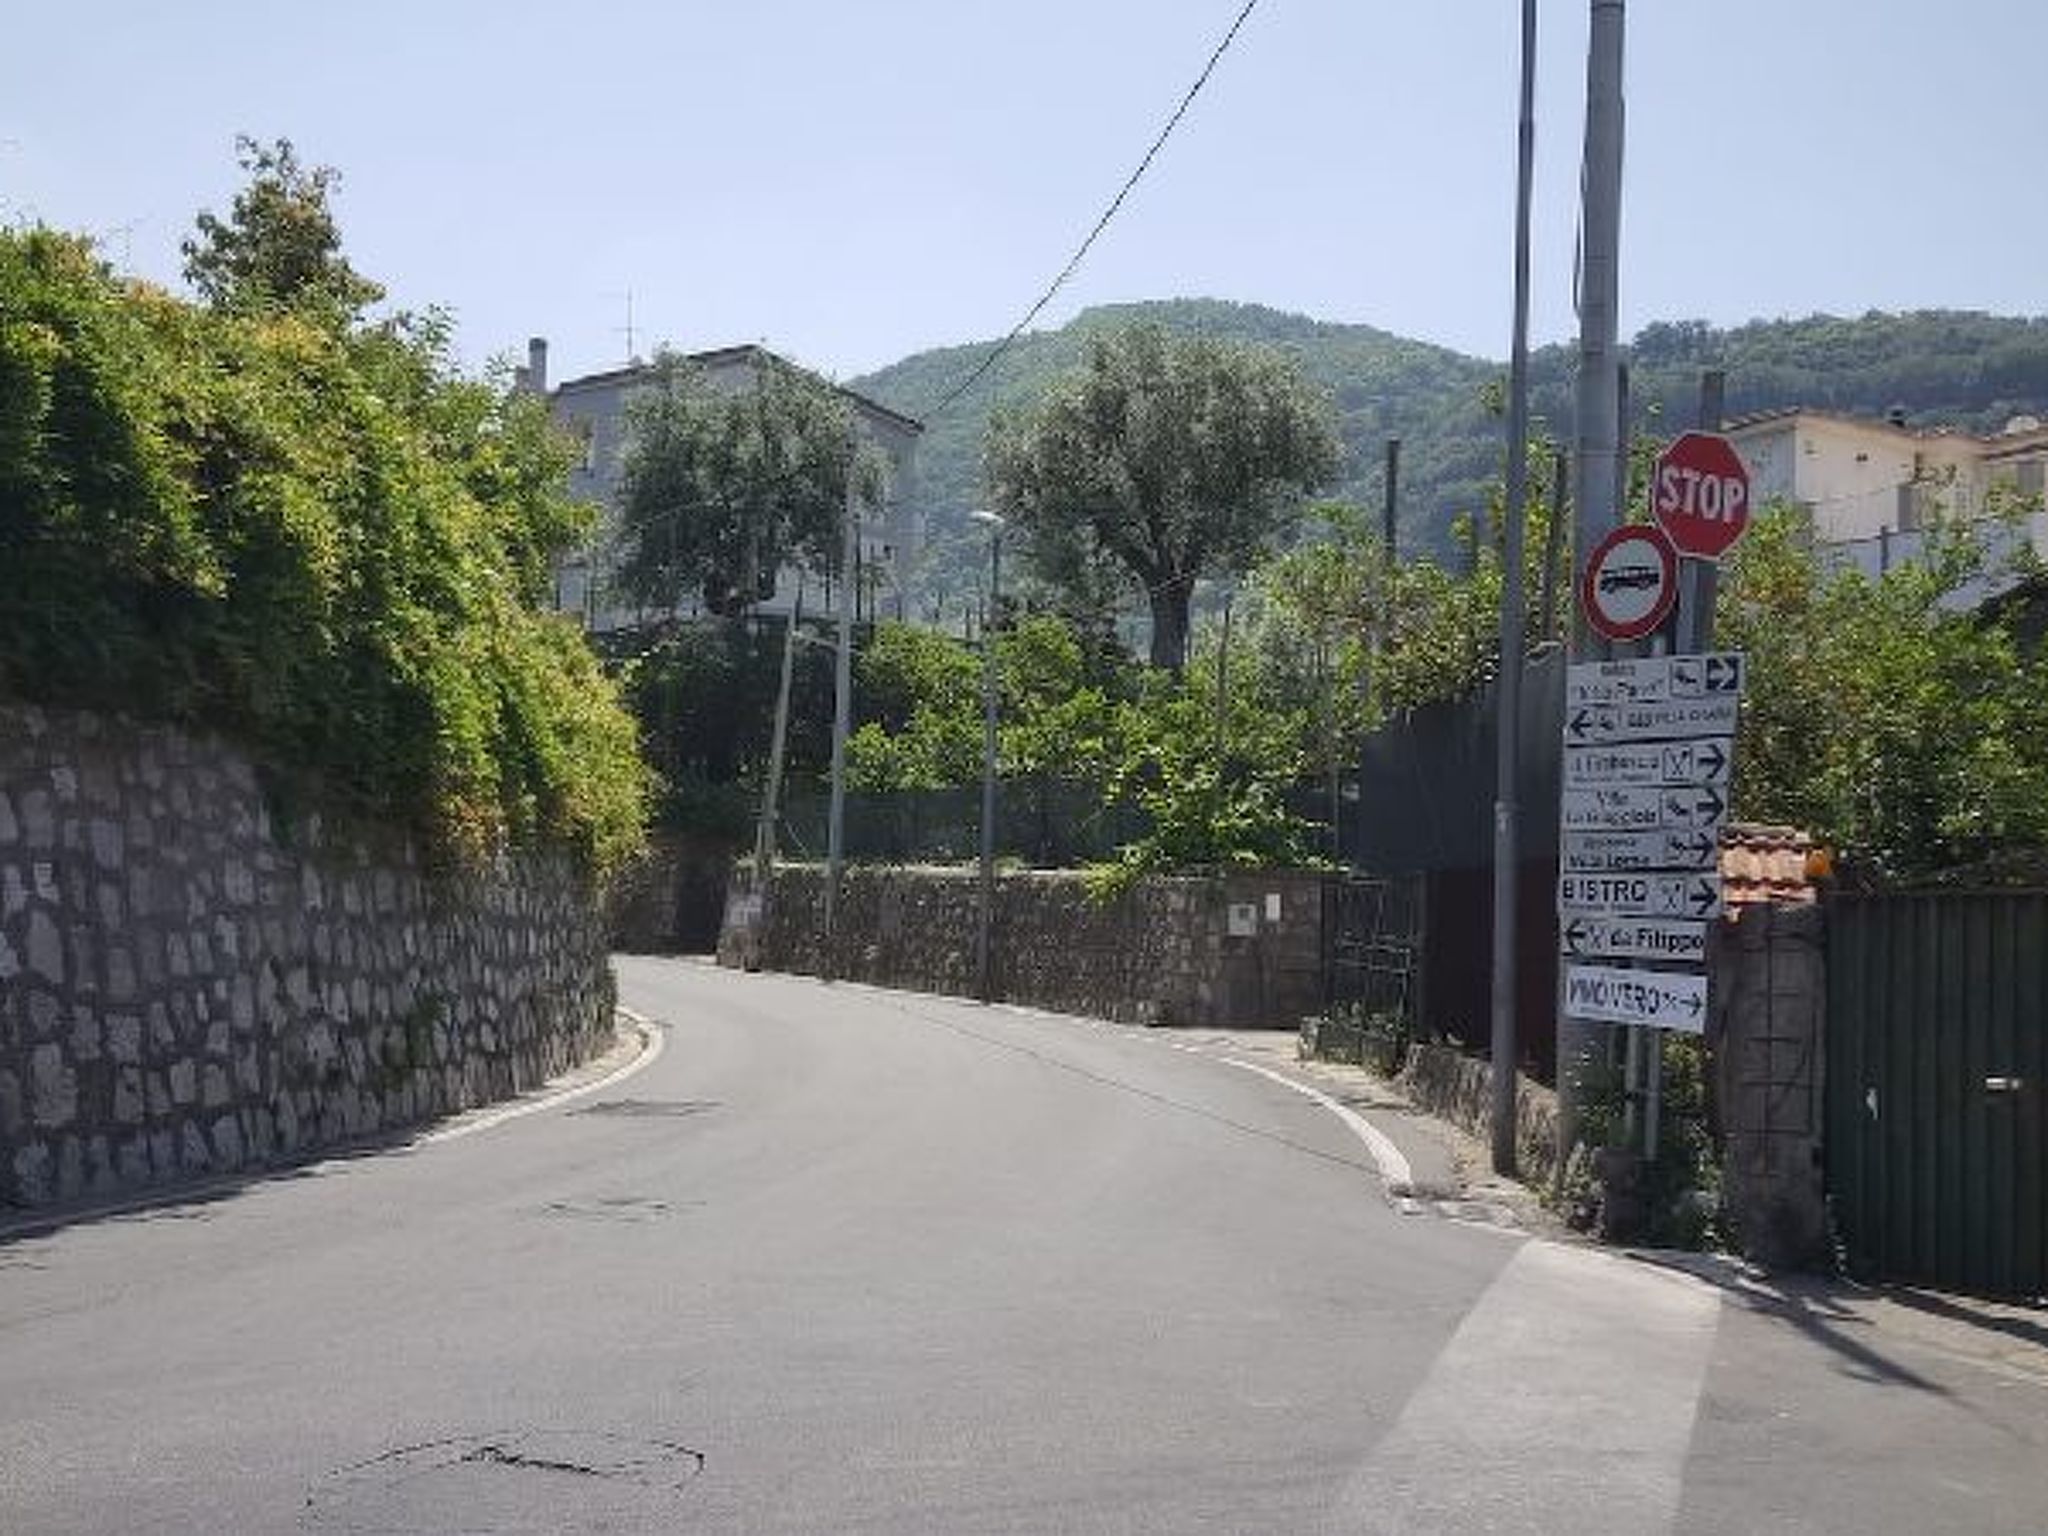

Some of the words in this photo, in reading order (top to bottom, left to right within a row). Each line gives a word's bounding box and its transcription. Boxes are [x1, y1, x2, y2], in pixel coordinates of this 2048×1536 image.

[1658, 465, 1744, 523] STOP
[1563, 879, 1647, 902] BISTRO
[1636, 928, 1705, 952] Filippo
